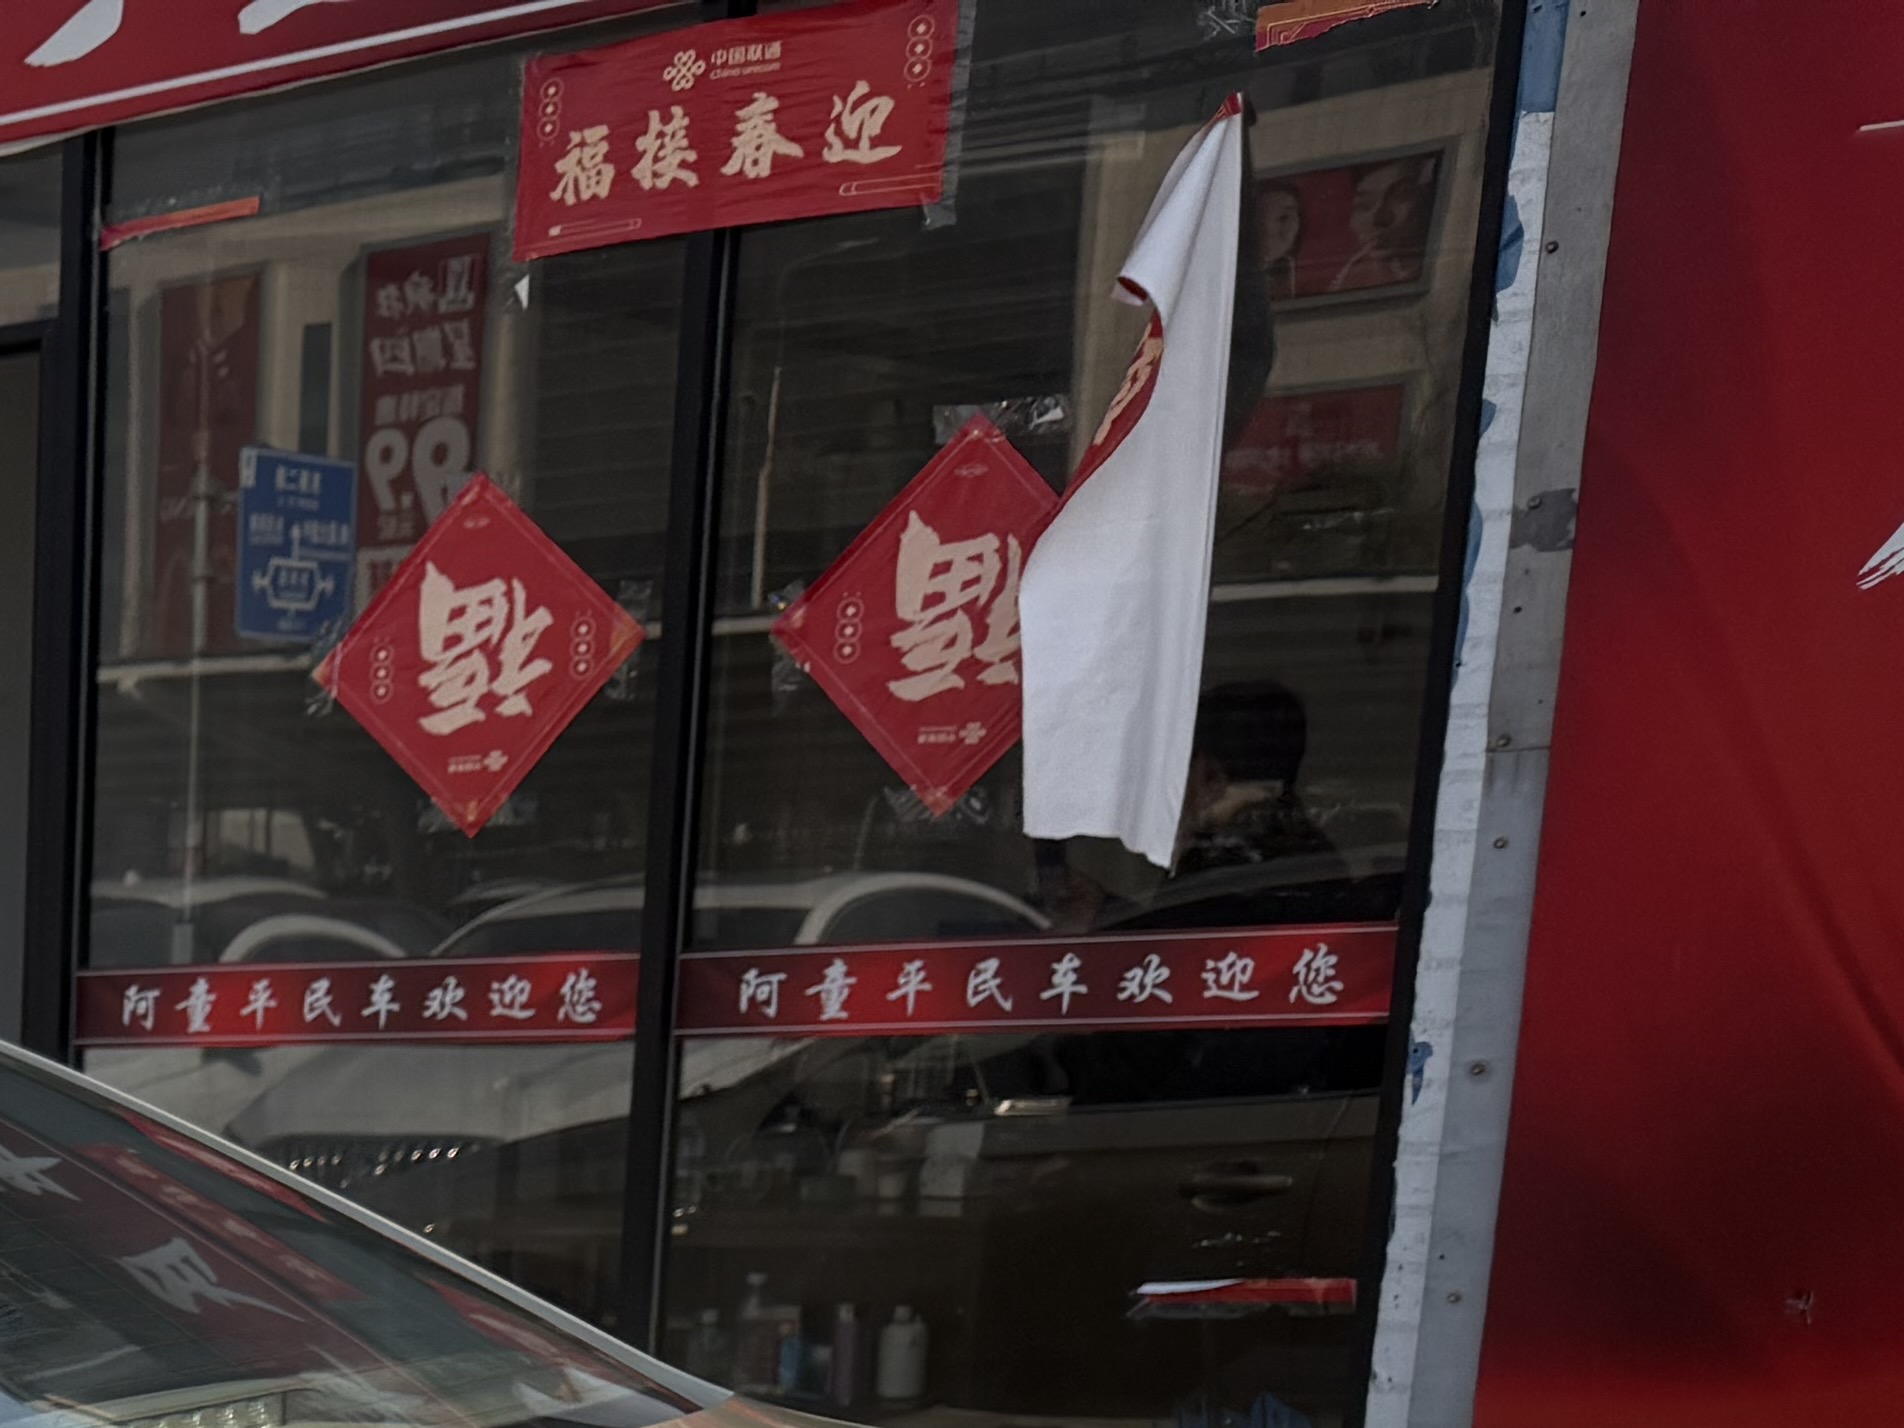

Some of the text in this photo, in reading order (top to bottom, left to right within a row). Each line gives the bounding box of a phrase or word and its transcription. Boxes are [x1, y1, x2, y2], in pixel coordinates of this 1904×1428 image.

[418, 560, 554, 736] 福
[121, 966, 604, 1034] 阿童平民车欢迎您
[737, 942, 1346, 1023] 阿童平民车欢迎您
